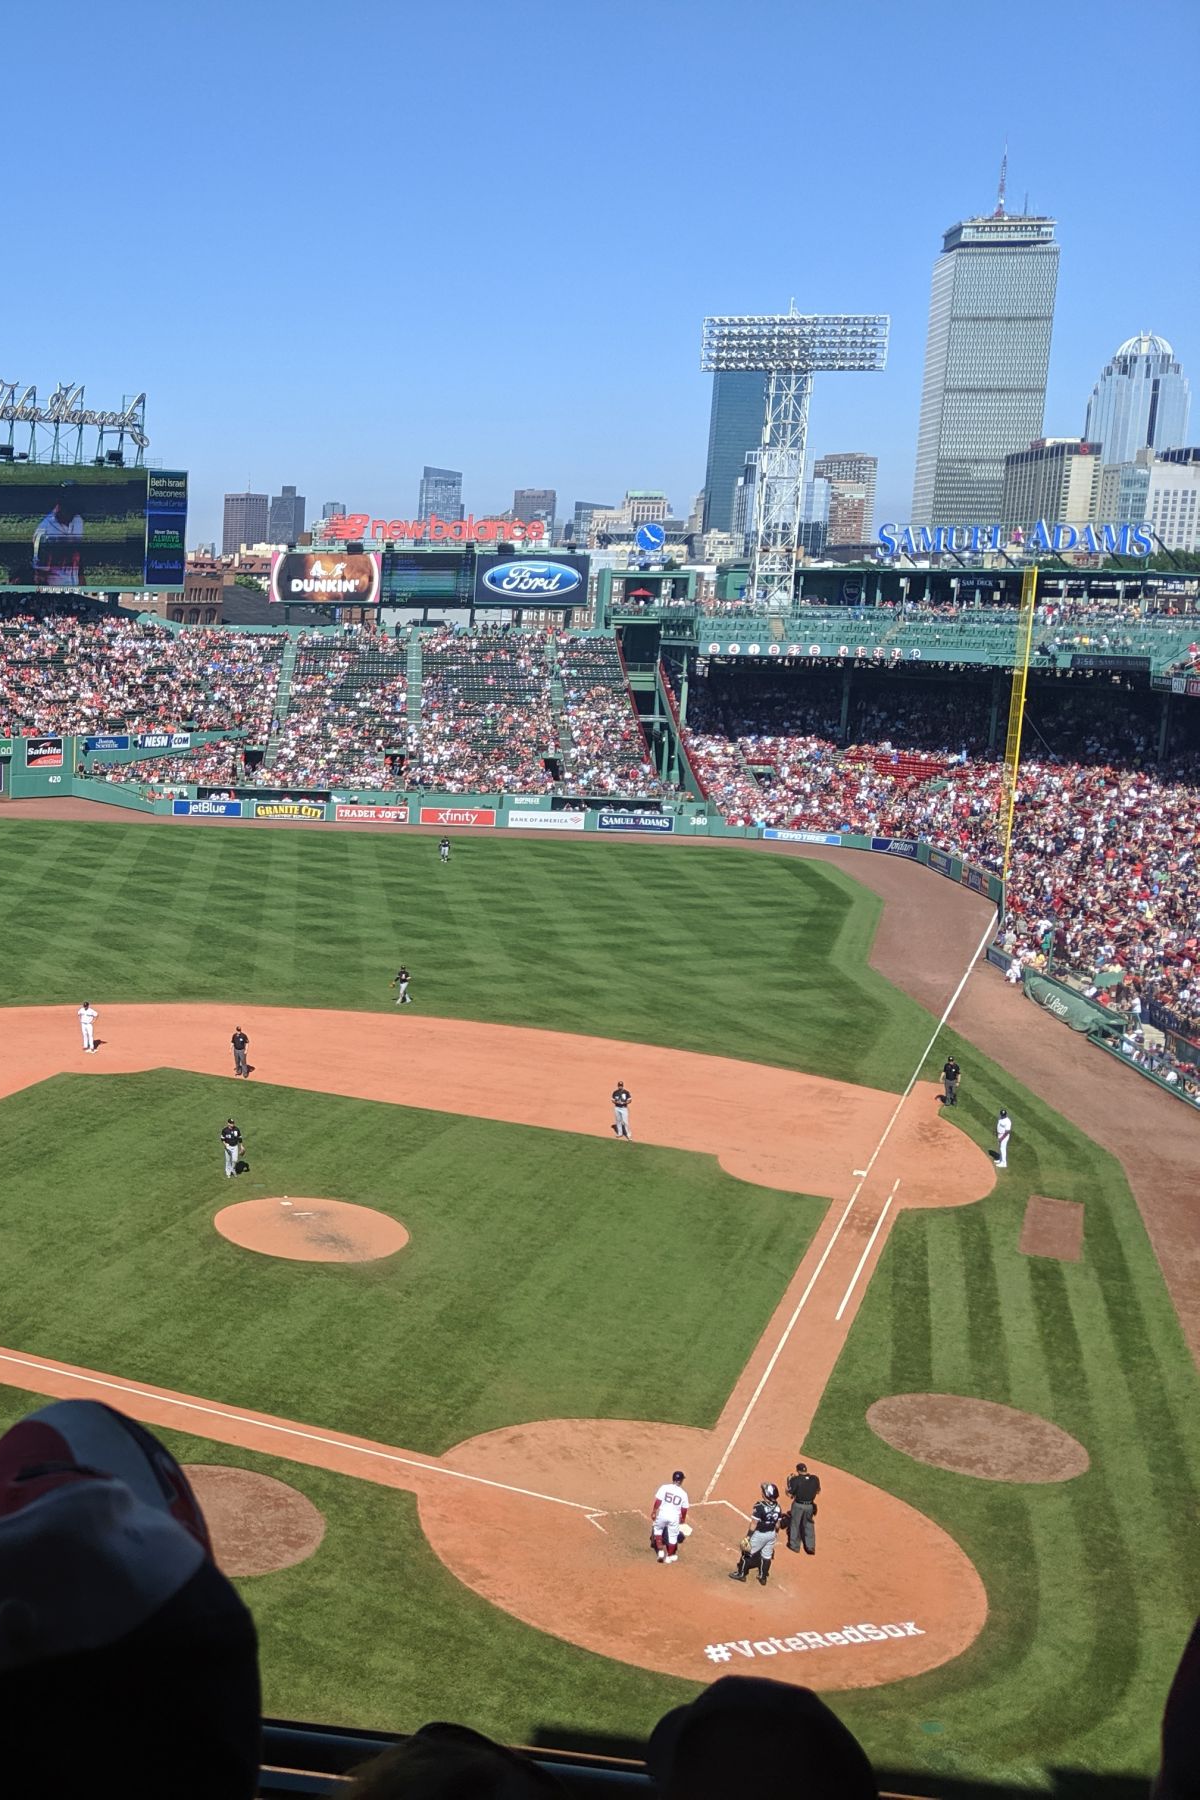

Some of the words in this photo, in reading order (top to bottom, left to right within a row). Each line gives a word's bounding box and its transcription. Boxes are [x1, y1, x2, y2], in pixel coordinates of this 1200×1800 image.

[42, 382, 150, 448] Hancock
[150, 478, 167, 487] Beth
[167, 478, 185, 488] Israel
[149, 488, 185, 498] Deaconess
[371, 518, 427, 540] new
[430, 514, 546, 541] balance
[877, 523, 1008, 557] SAMUEL
[1028, 518, 1155, 558] ADAMS
[502, 565, 562, 591] Ford
[291, 578, 360, 594] DUNKIN'
[144, 736, 168, 748] NESN
[28, 746, 62, 755] Safelite
[48, 775, 61, 783] 420
[188, 801, 226, 813] jetBlue
[257, 805, 300, 816] GRANITE
[301, 805, 324, 818] CITY
[339, 809, 376, 818] TRADER
[378, 810, 407, 819] JOE'S
[437, 810, 478, 825] xfinity
[602, 816, 636, 826] SAMUEL
[638, 818, 670, 828] ADAMS
[690, 817, 708, 826] 380
[776, 831, 800, 839] TOYO
[801, 834, 826, 842] TIRES
[664, 1492, 682, 1506] 50
[703, 1620, 926, 1663] #VoteRedSox
